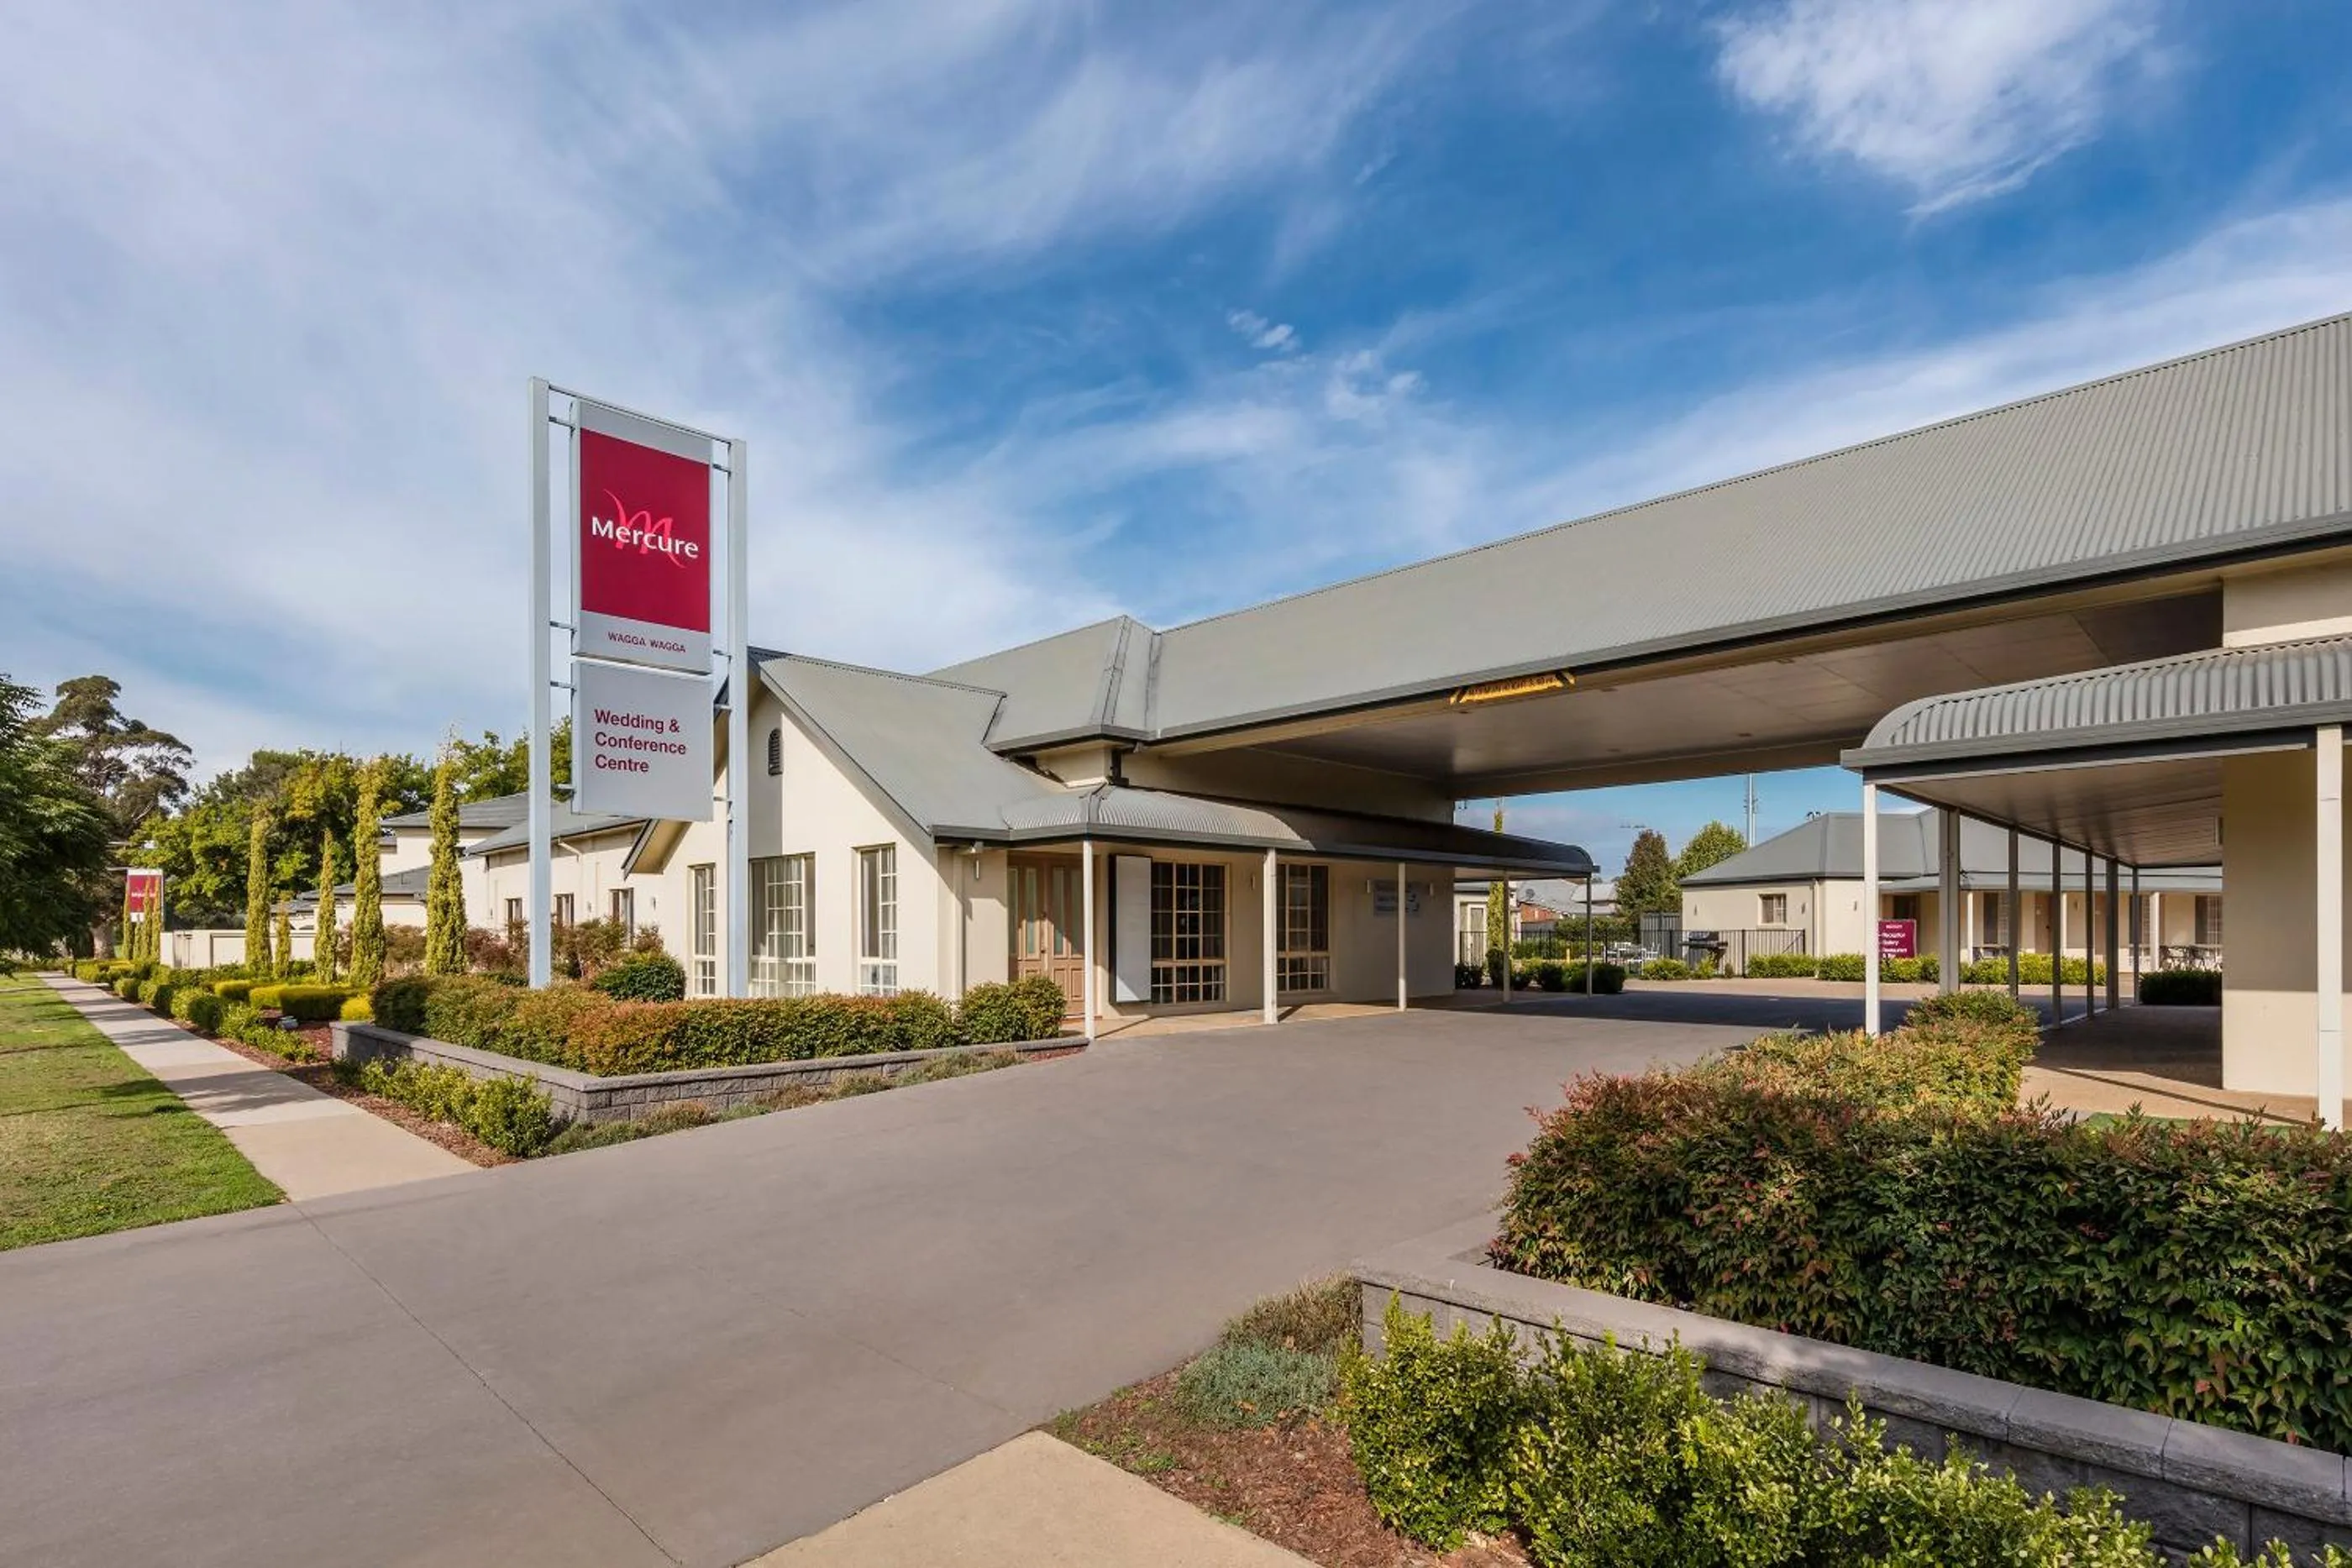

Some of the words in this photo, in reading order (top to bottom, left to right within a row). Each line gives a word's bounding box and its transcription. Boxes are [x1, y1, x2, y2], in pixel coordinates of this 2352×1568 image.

[591, 515, 700, 559] Mercure
[607, 631, 647, 648] WAGGA
[649, 639, 686, 653] WAGGA
[594, 708, 664, 735] Wedding
[669, 719, 680, 733] &
[595, 731, 687, 755] Conference
[595, 753, 650, 773] Centre
